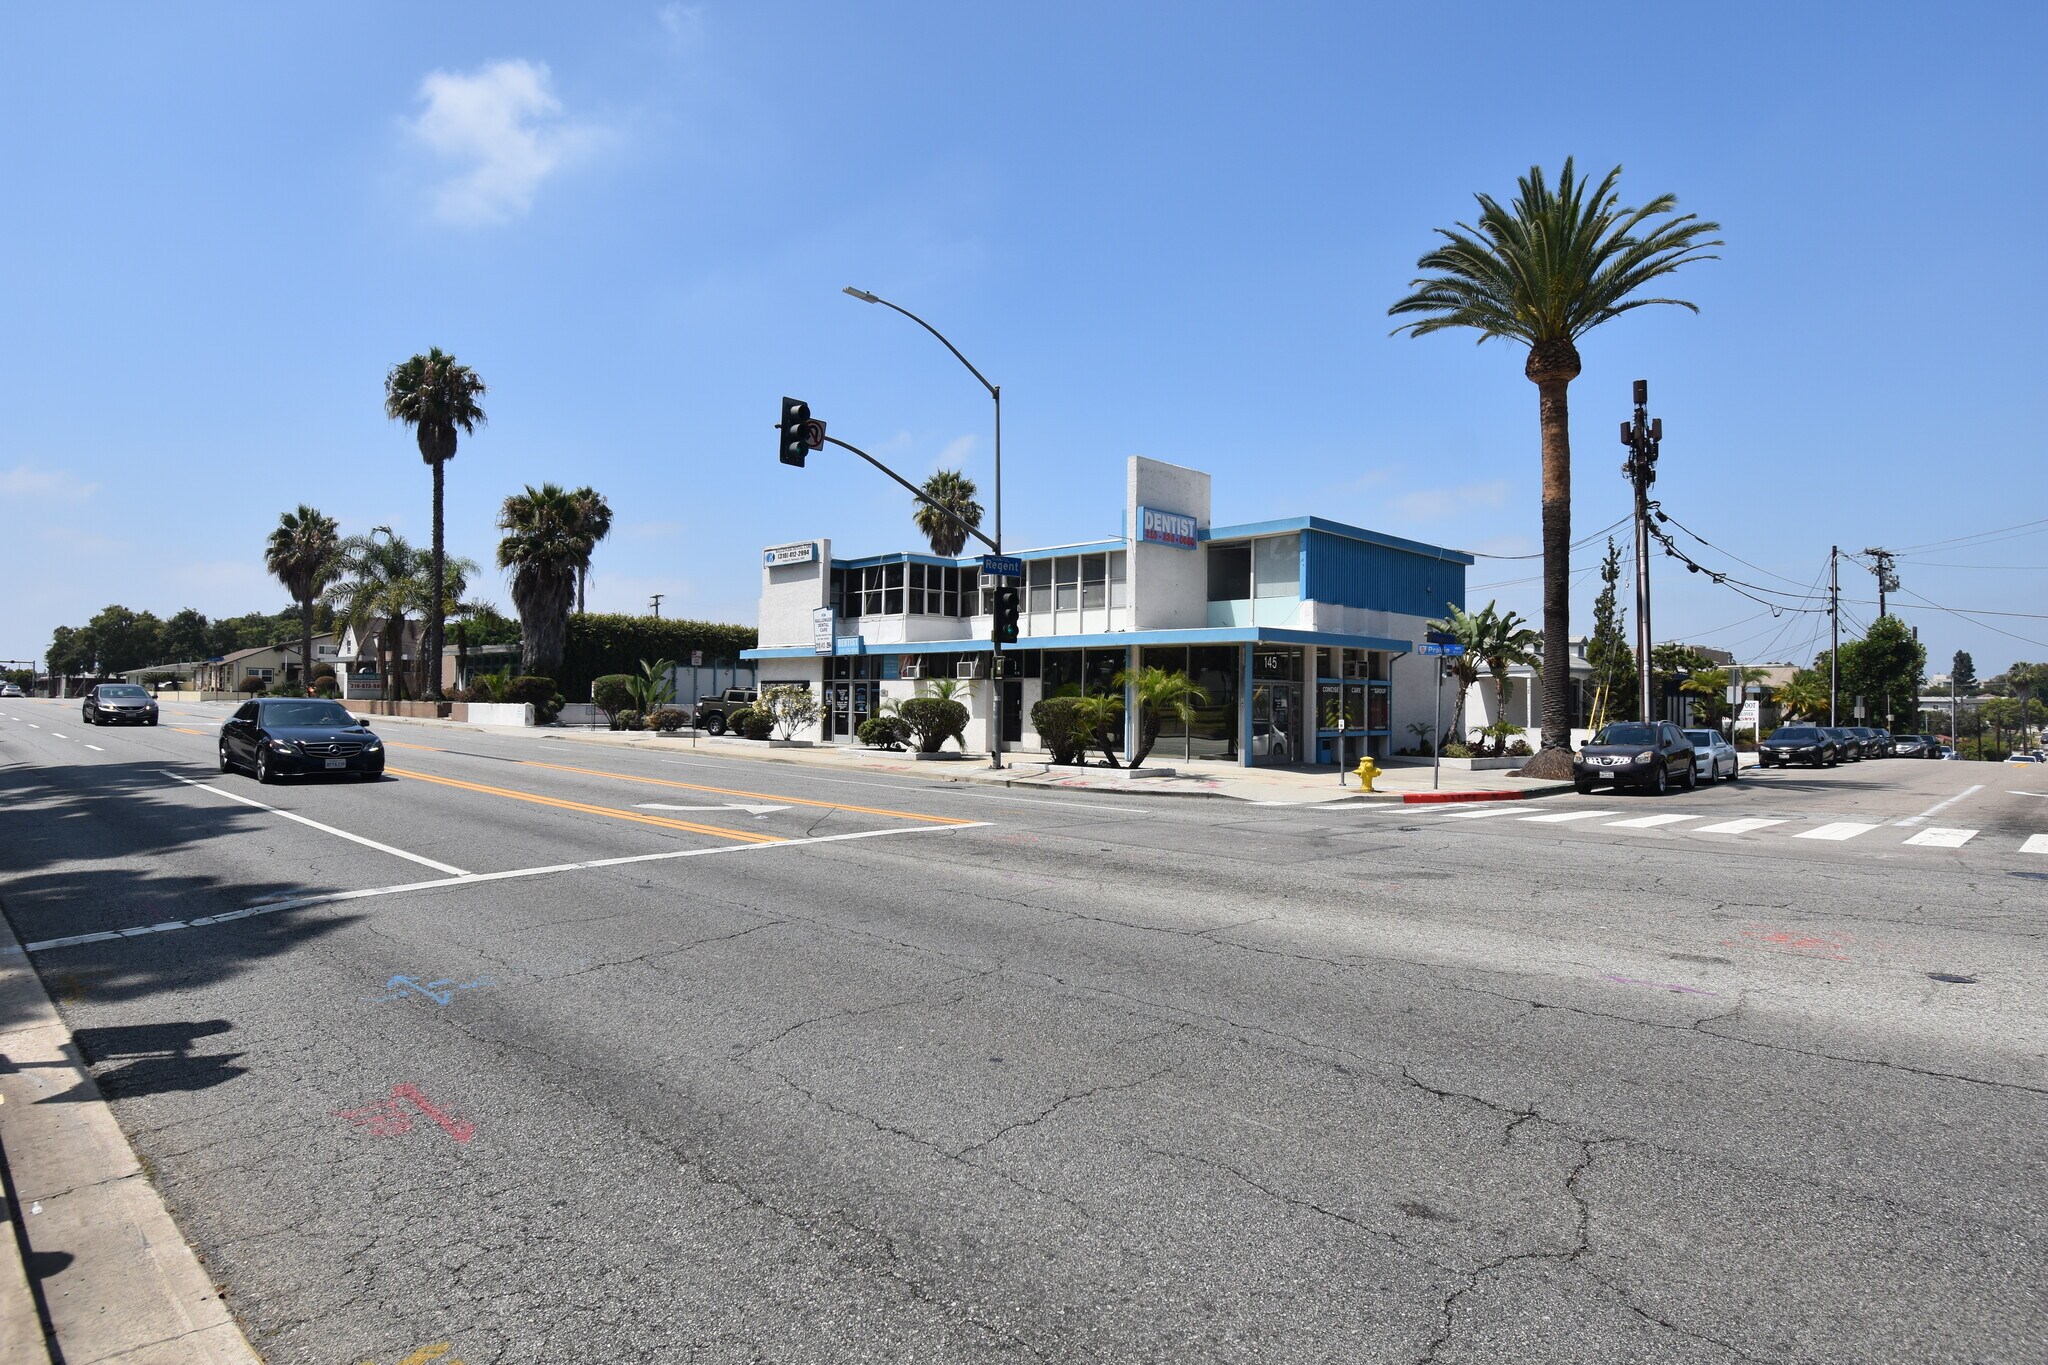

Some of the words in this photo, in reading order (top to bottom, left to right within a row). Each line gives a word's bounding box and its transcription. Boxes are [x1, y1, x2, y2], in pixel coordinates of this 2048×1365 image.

[1144, 511, 1195, 537] DENTIST
[985, 559, 1019, 573] Regent
[1264, 656, 1277, 669] 145
